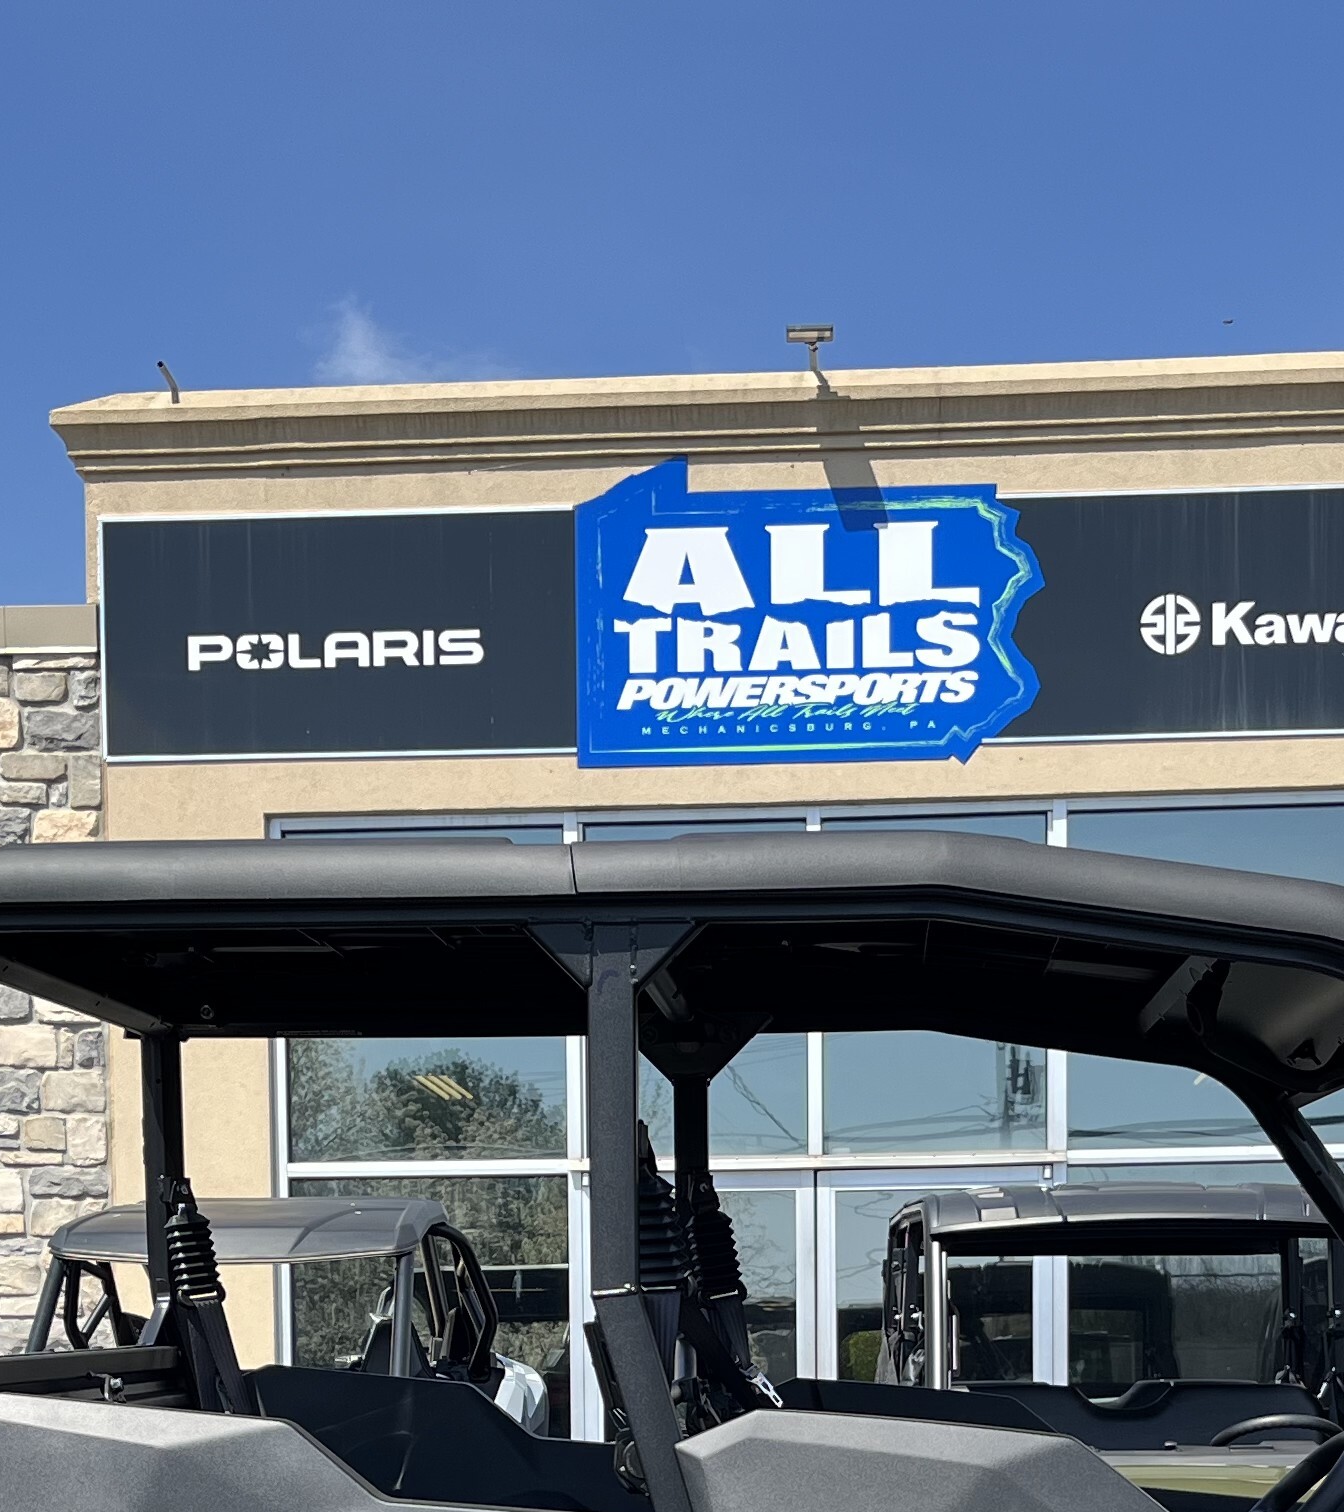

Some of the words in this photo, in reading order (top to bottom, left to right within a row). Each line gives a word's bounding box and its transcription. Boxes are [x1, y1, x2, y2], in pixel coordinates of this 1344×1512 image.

[622, 520, 980, 616] ALL
[187, 629, 484, 671] POLARIS
[613, 610, 980, 674] TRAILS
[616, 670, 979, 710] POWERSPORTS
[909, 719, 936, 730] PA
